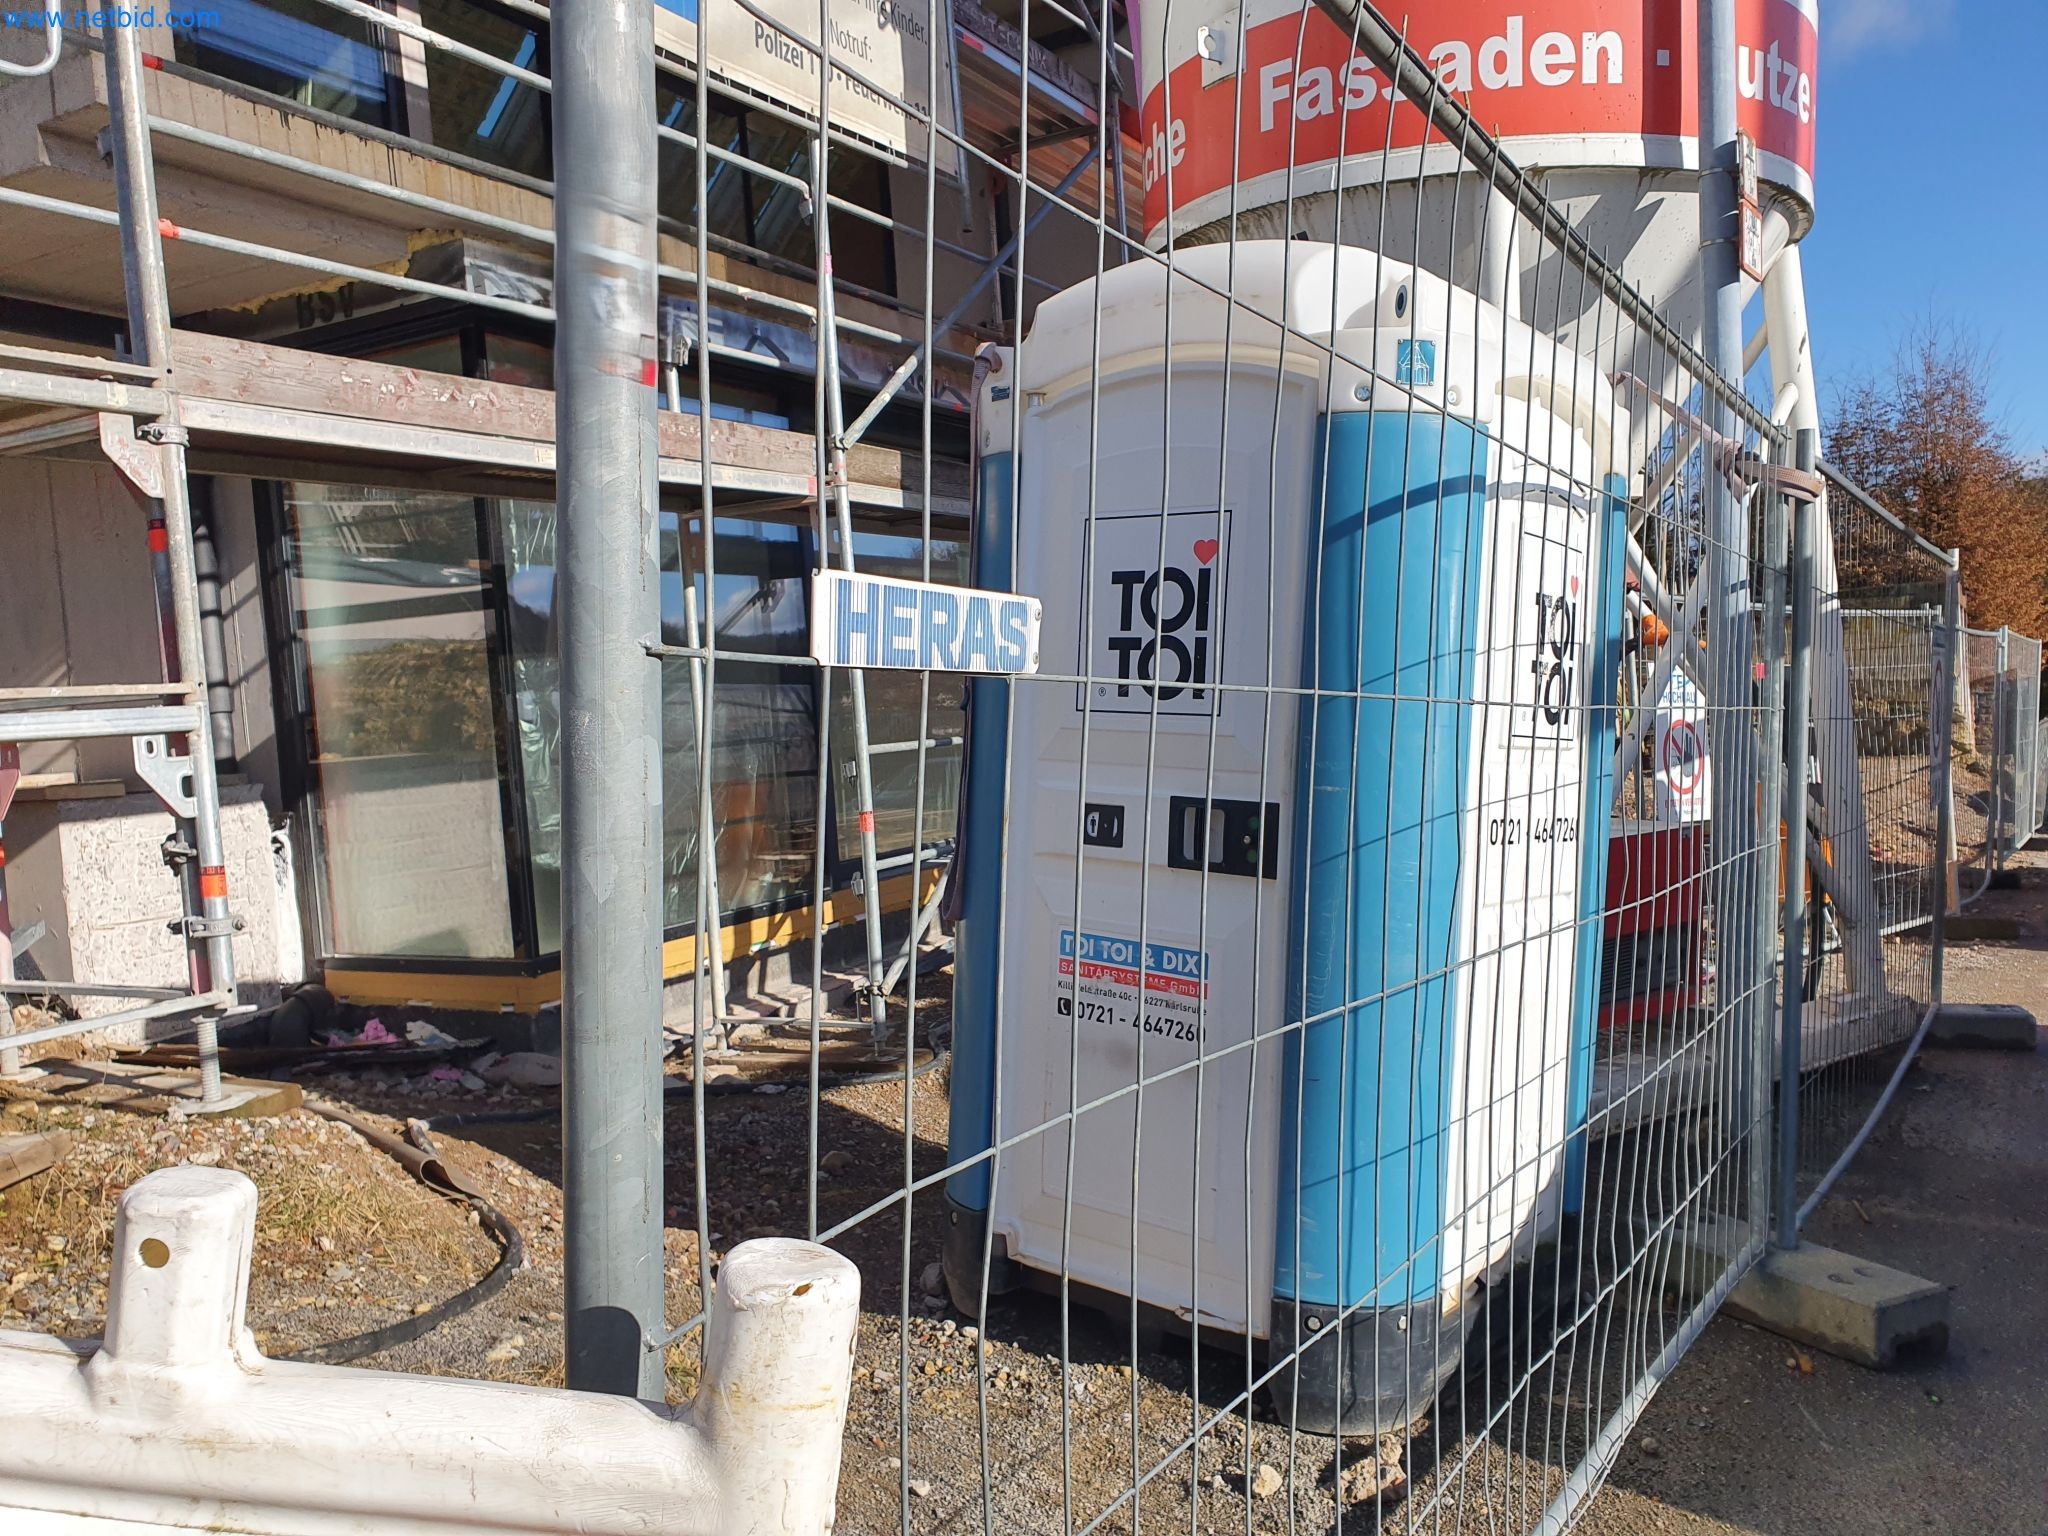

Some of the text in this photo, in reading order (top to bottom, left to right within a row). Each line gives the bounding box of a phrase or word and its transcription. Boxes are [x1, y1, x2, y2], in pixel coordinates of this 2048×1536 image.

[754, 20, 805, 70] Polizei
[829, 17, 872, 63] Notruf:
[890, 2, 928, 45] Kinder.
[1738, 39, 1811, 124] utze
[1111, 566, 1211, 633] TOI
[836, 578, 1028, 673] HERAS
[1535, 592, 1576, 661] TOI
[1108, 634, 1206, 700] TOI
[1531, 660, 1574, 726] TOI
[1490, 817, 1578, 846] 0721 464726
[1063, 934, 1094, 957] TOI
[1100, 940, 1133, 963] TOI
[1162, 950, 1200, 975] DIX
[1077, 1001, 1114, 1025] 0721
[1144, 996, 1164, 1008] 6227
